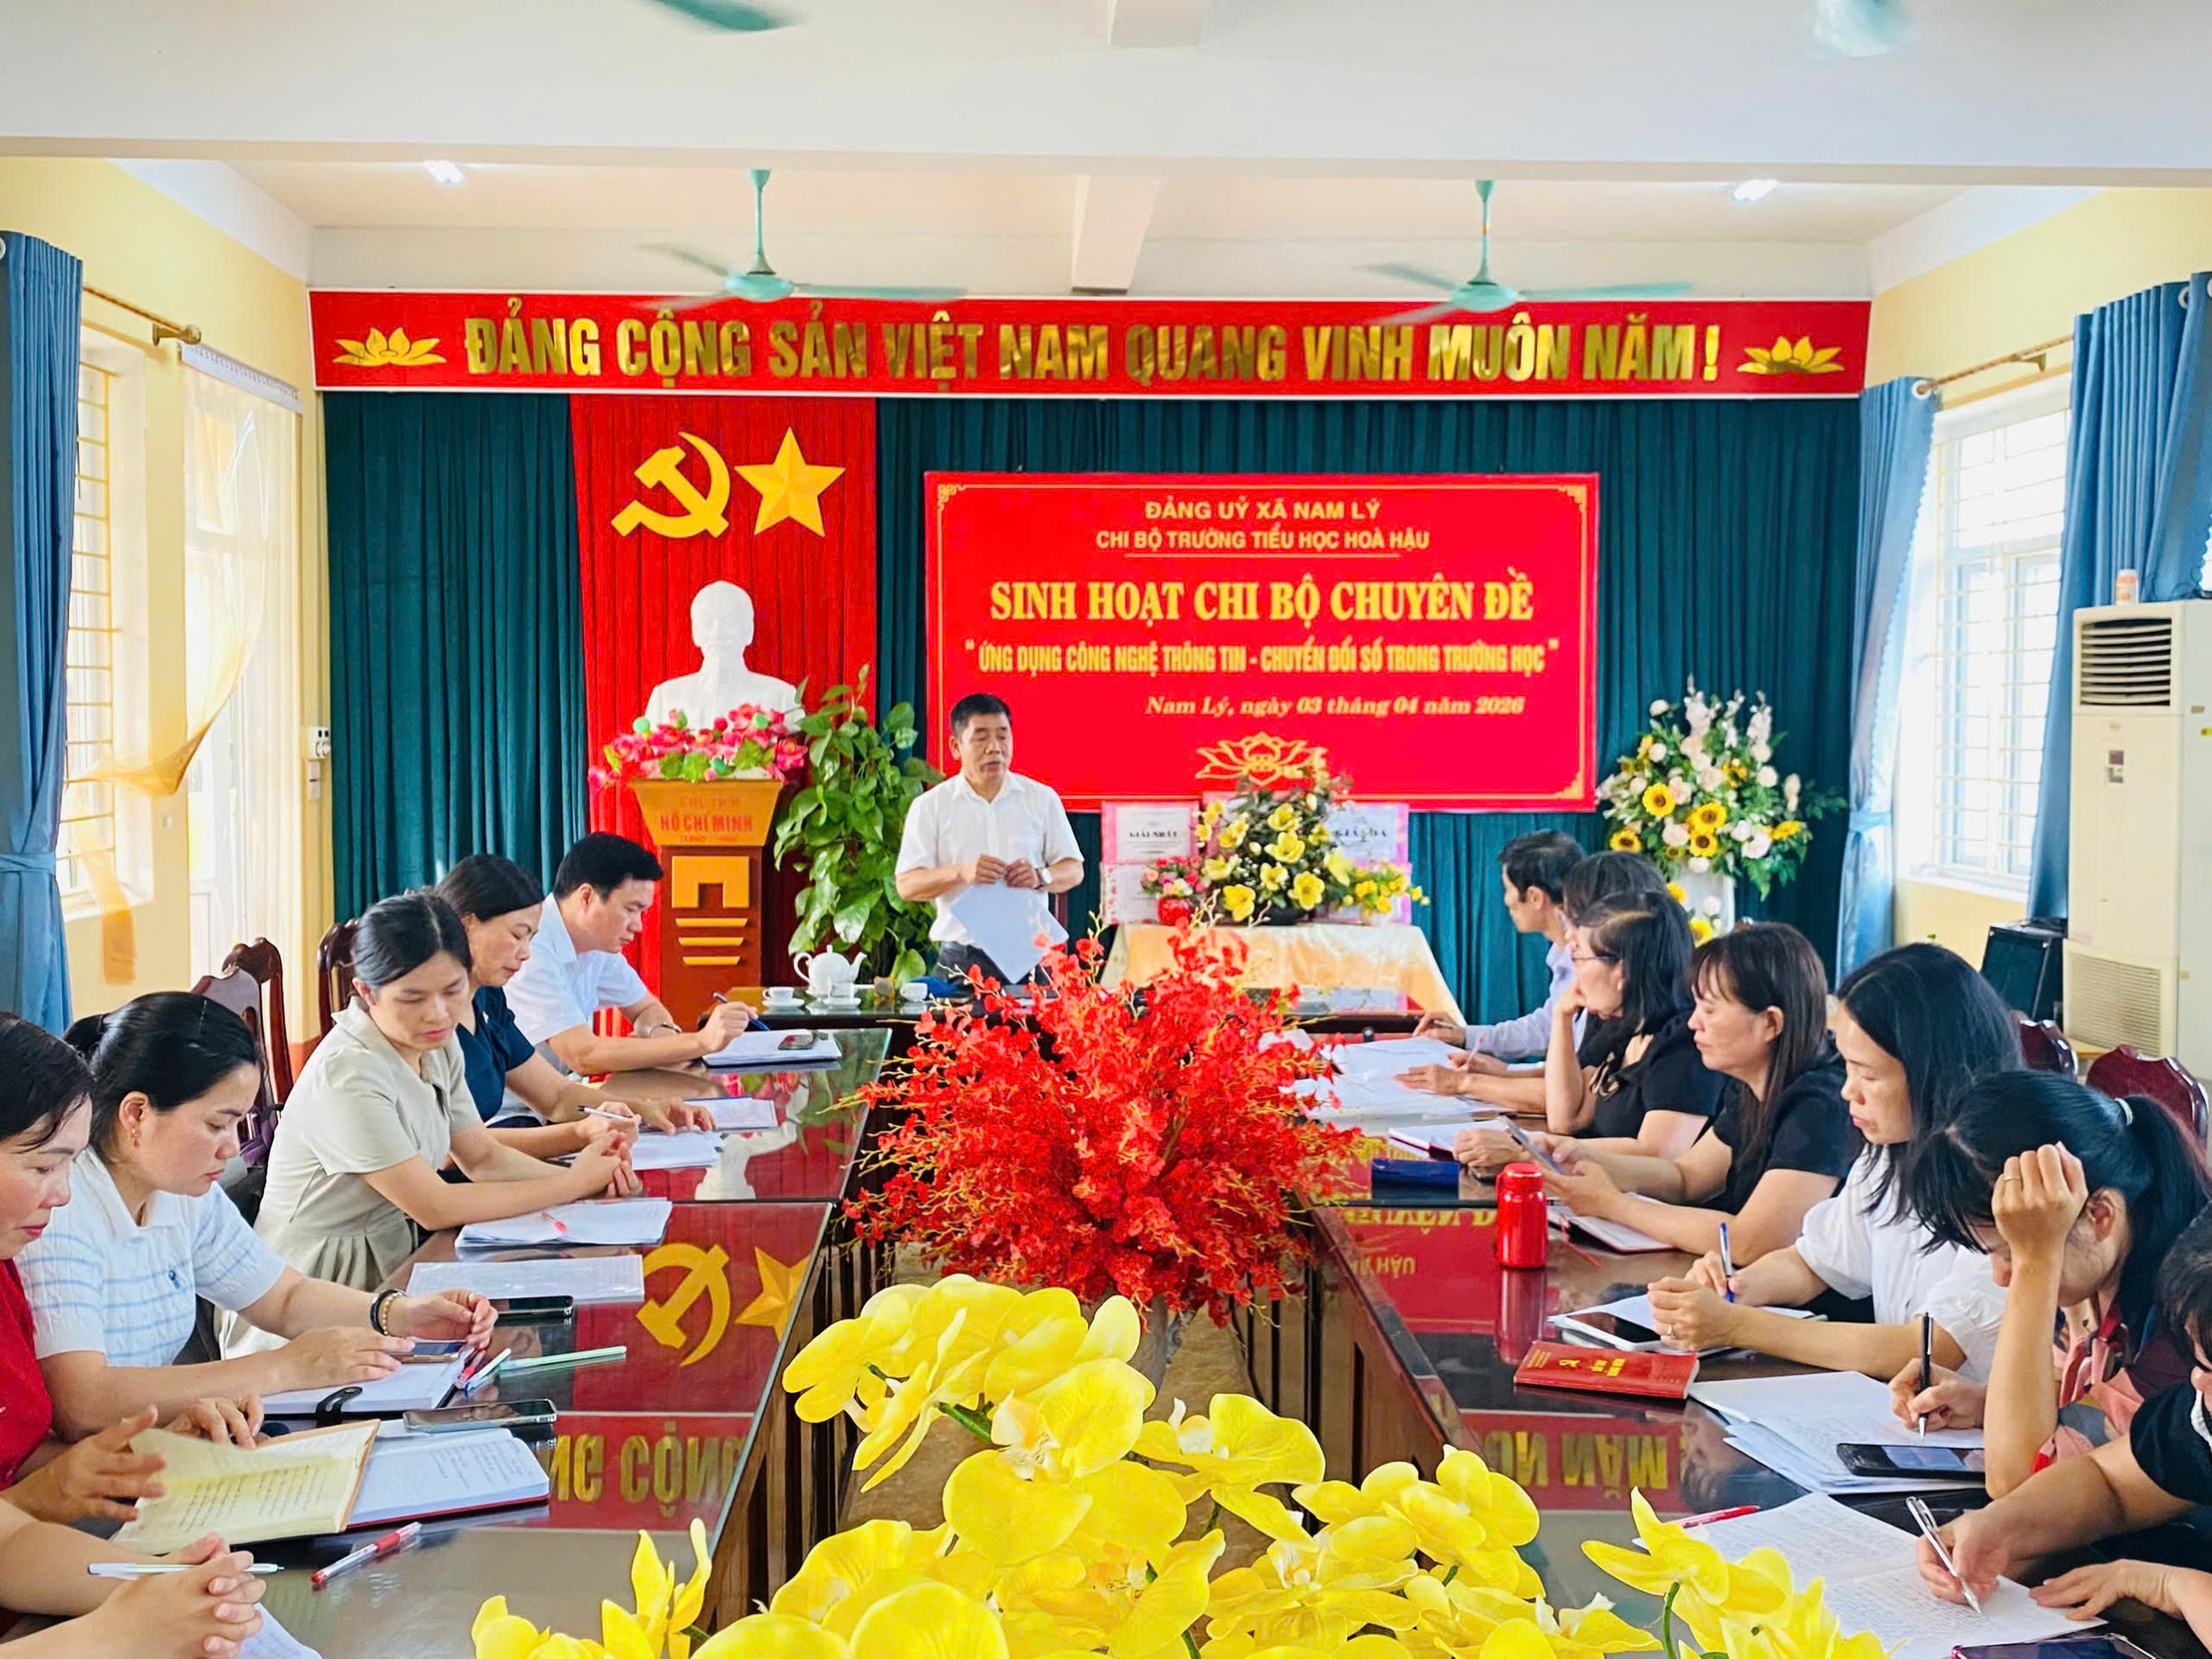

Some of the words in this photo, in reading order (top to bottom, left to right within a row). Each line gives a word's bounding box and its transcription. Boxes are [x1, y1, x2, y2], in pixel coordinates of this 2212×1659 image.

[464, 296, 602, 377] ĐẢNG
[616, 306, 752, 388] CỘNG
[768, 300, 868, 379] SẢN
[881, 310, 984, 392] VIỆT
[999, 324, 1109, 380] NAM
[1125, 324, 1287, 387] QUANG
[1302, 325, 1414, 381] VINH
[1427, 312, 1571, 382] MUÔN
[1145, 496, 1211, 519] ĐẢNG
[1218, 496, 1250, 519] UỶ
[1256, 498, 1287, 519] XÃ
[1294, 501, 1344, 519] NAM
[1351, 496, 1381, 519] LÝ
[1096, 531, 1129, 549] CHI
[1134, 527, 1162, 552] BỘ
[1166, 527, 1246, 550] TRƯỜNG
[1252, 523, 1294, 549] TIỂU
[1299, 531, 1338, 552] HỌC
[1344, 526, 1383, 549] HOÀ
[1389, 527, 1429, 552] HẬU
[991, 582, 1077, 620] SINH
[1087, 582, 1185, 627] HOẠT
[1194, 582, 1259, 620] CHI
[1270, 572, 1320, 629] BỘ
[1330, 572, 1475, 620] CHUYÊN
[1483, 565, 1534, 620] ĐỀ
[1017, 645, 1062, 677] DỤNG
[1065, 640, 1110, 672] CÔNG
[1115, 640, 1158, 677] NGHỆ
[1162, 640, 1216, 672] THÔNG
[1220, 645, 1247, 672] TIN
[1360, 635, 1383, 672] SỐ
[1386, 645, 1440, 672] TRONG
[1443, 639, 1508, 672] TRƯỜNG
[1145, 696, 1196, 715] Nam
[1201, 696, 1235, 718] Lý,
[1240, 696, 1293, 718] ngày
[1296, 696, 1324, 715] 03
[1327, 696, 1392, 718] tháng
[1394, 696, 1420, 715] 04
[1423, 697, 1471, 715] năm
[1475, 696, 1527, 715] 2026
[712, 815, 753, 831] MINH
